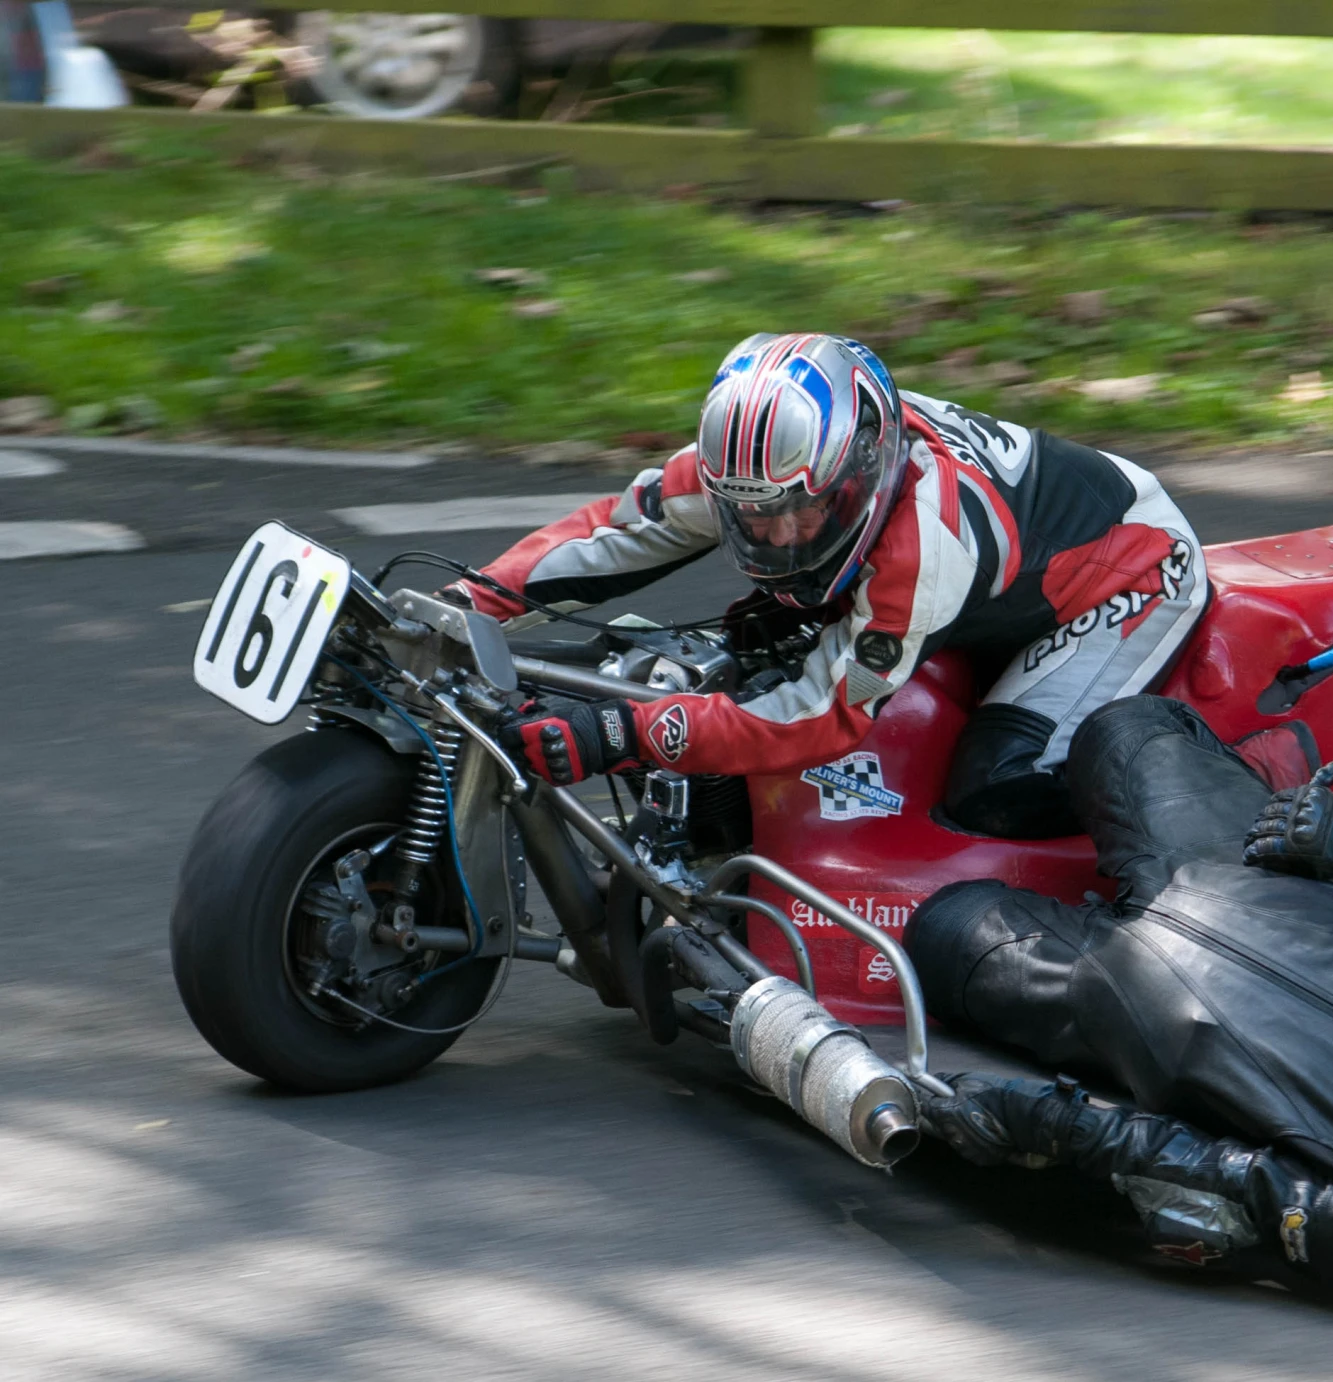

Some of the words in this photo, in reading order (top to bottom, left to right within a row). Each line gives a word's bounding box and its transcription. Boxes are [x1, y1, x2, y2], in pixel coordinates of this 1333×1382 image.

[723, 483, 773, 493] KBC
[204, 540, 328, 703] 161
[859, 784, 899, 807] MOUNT
